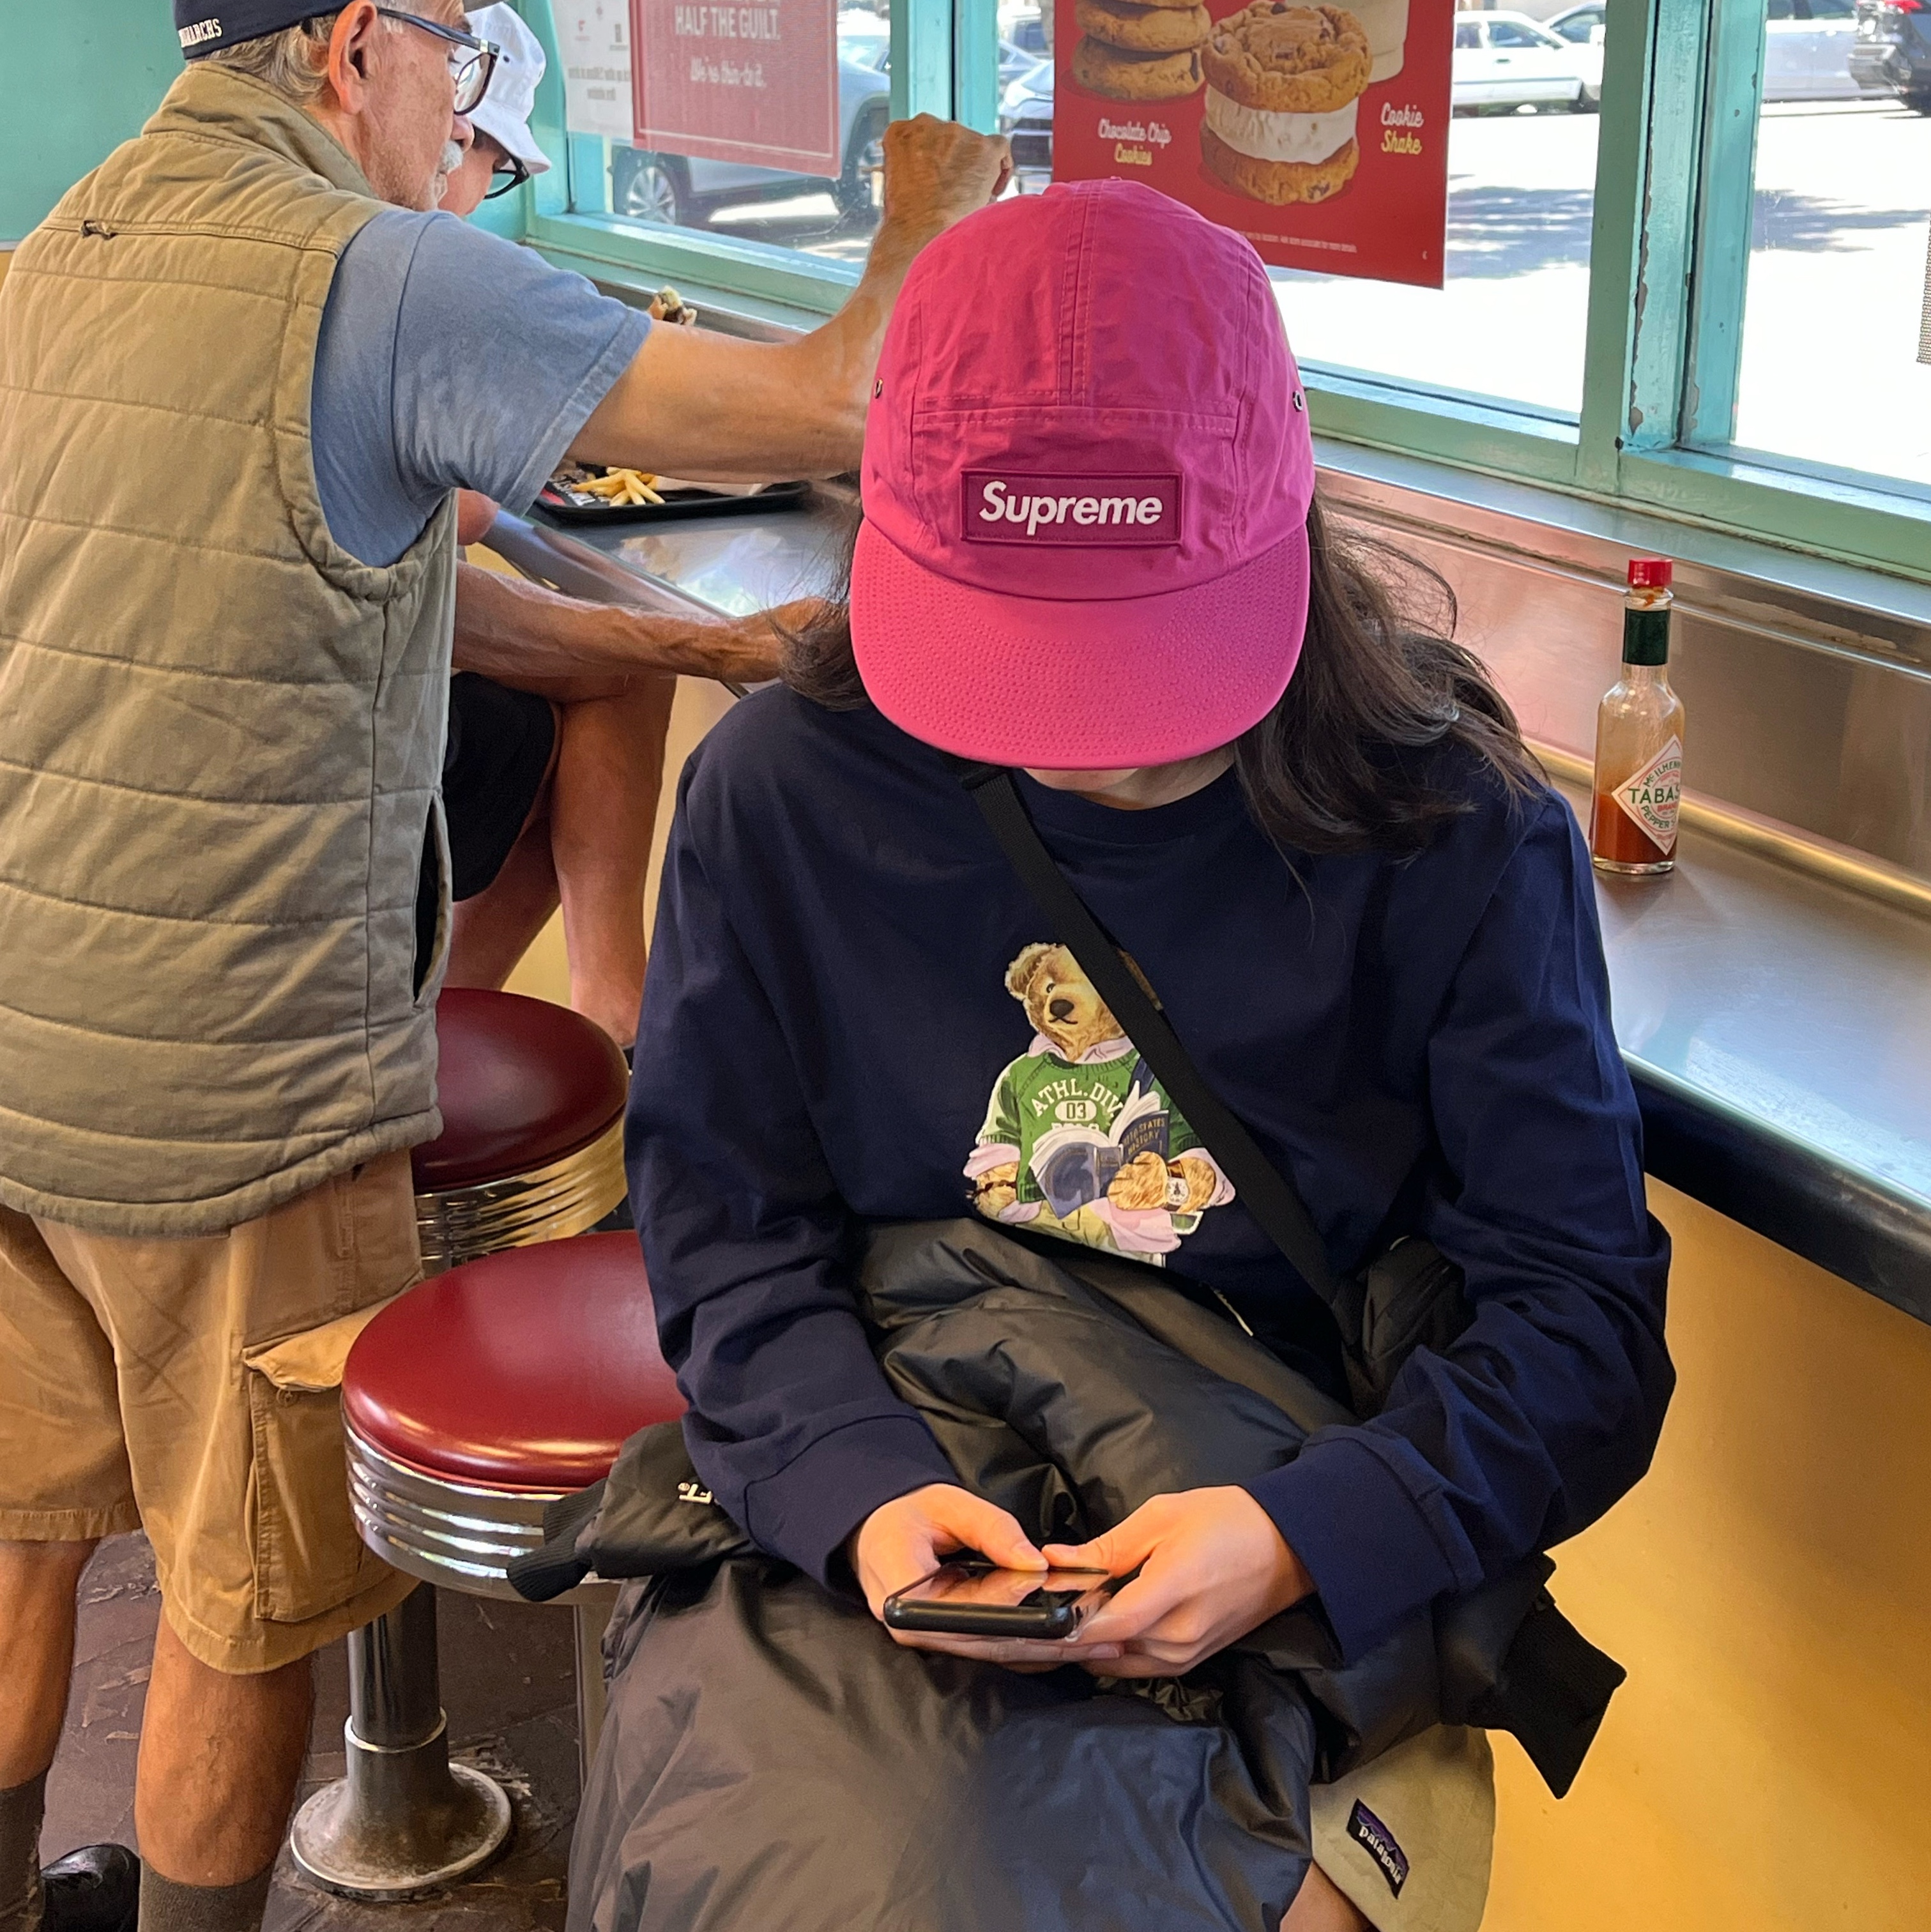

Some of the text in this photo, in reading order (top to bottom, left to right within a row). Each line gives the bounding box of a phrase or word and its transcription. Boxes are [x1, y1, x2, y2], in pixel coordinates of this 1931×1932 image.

[675, 6, 781, 40] HALF THE GUILT.
[1380, 102, 1424, 128] Cookie
[1097, 118, 1172, 149] Chocolate Chip
[1380, 129, 1423, 155] Shake
[1113, 142, 1152, 166] Cookies
[979, 480, 1163, 536] Supreme
[1641, 805, 1670, 828] PEPPER
[1066, 1102, 1087, 1119] 03
